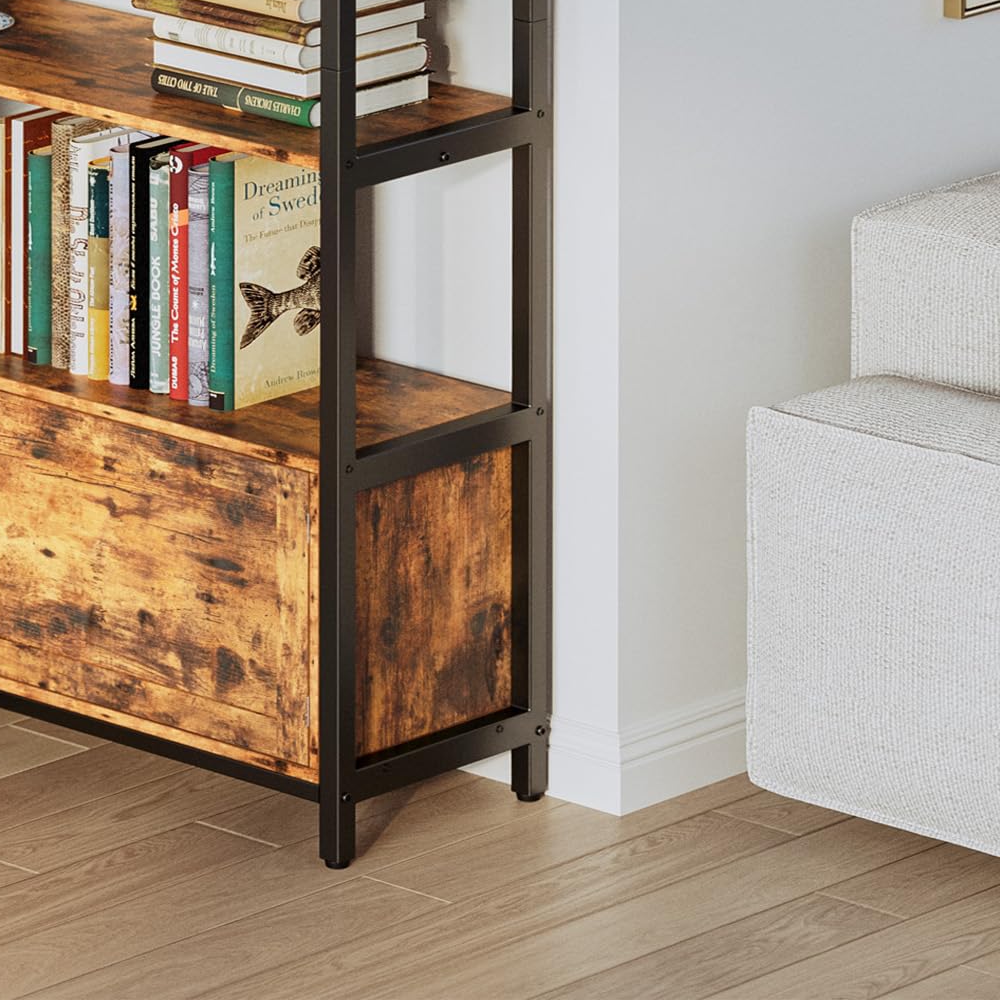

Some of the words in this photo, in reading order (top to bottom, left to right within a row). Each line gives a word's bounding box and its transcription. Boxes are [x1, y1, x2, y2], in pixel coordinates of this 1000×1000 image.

[244, 94, 273, 111] DICKENS
[272, 100, 301, 117] CHARLES
[150, 198, 158, 242] SABU
[252, 206, 265, 221] of
[268, 185, 321, 217] Swed
[171, 238, 180, 278] Monte
[151, 256, 161, 301] BOOK
[171, 287, 179, 321] Count
[151, 304, 161, 358] JUNGLE
[171, 323, 179, 343] The
